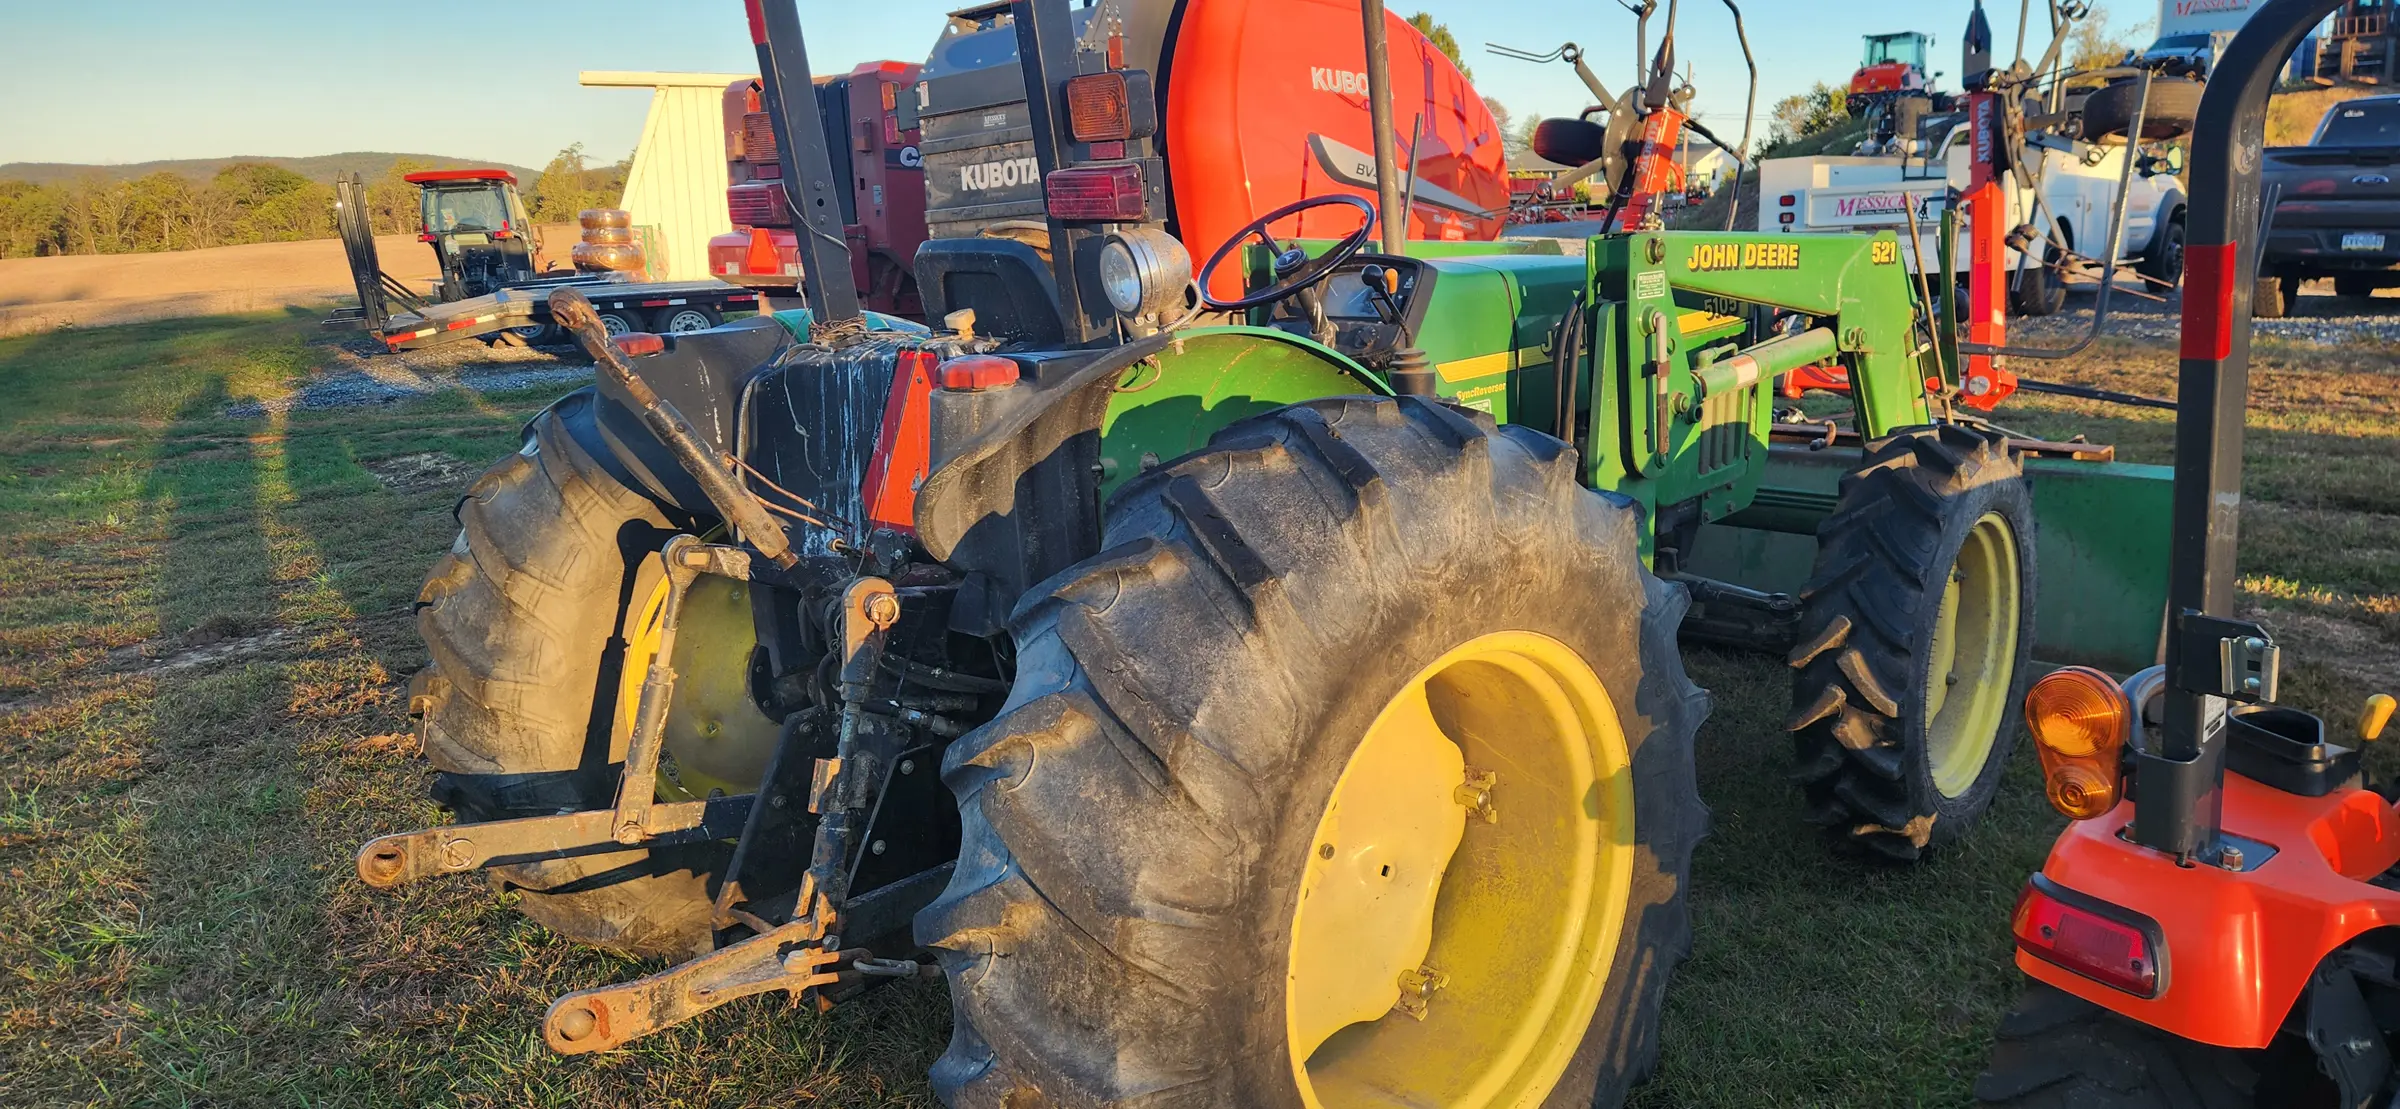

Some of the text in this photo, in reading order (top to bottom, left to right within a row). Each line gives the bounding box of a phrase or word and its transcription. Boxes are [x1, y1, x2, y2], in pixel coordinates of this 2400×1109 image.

[1310, 66, 1370, 97] KUBO
[960, 157, 1041, 191] KUBOTA
[1687, 243, 1800, 272] JOHN DEERE
[1871, 240, 1898, 266] 521
[1704, 297, 1738, 321] 5105
